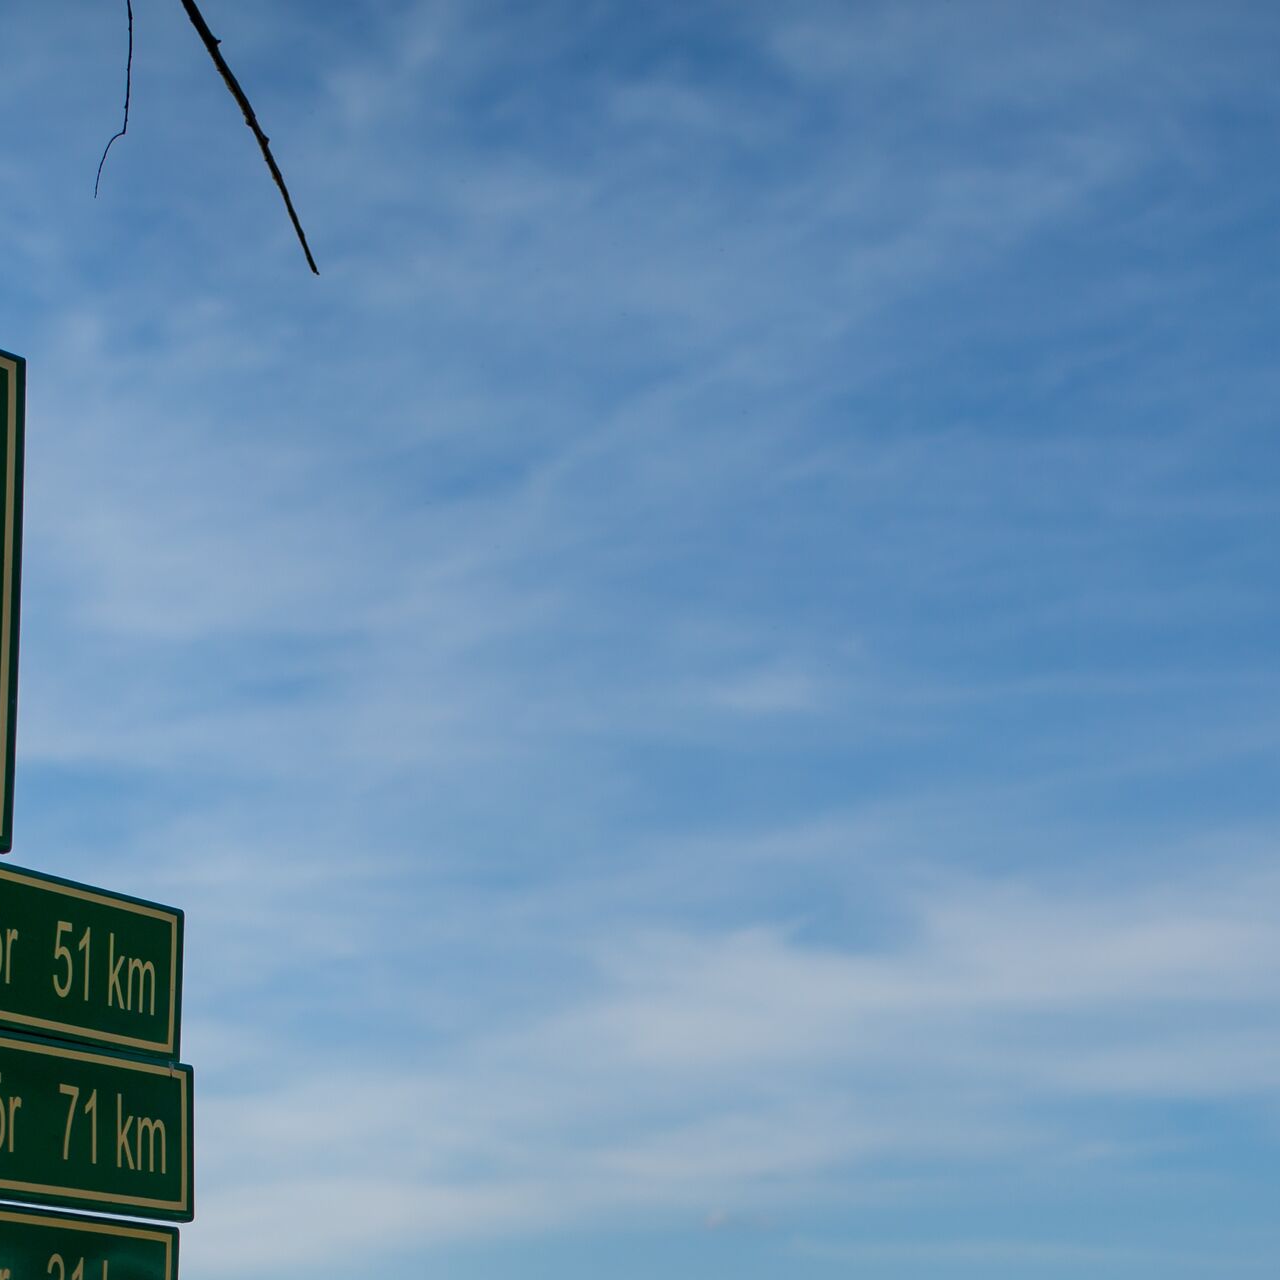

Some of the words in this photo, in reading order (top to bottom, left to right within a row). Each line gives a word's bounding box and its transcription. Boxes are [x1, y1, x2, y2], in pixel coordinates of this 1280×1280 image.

[54, 921, 90, 1000] 51
[109, 933, 155, 1015] km
[60, 1084, 96, 1163] 71
[117, 1094, 165, 1173] km
